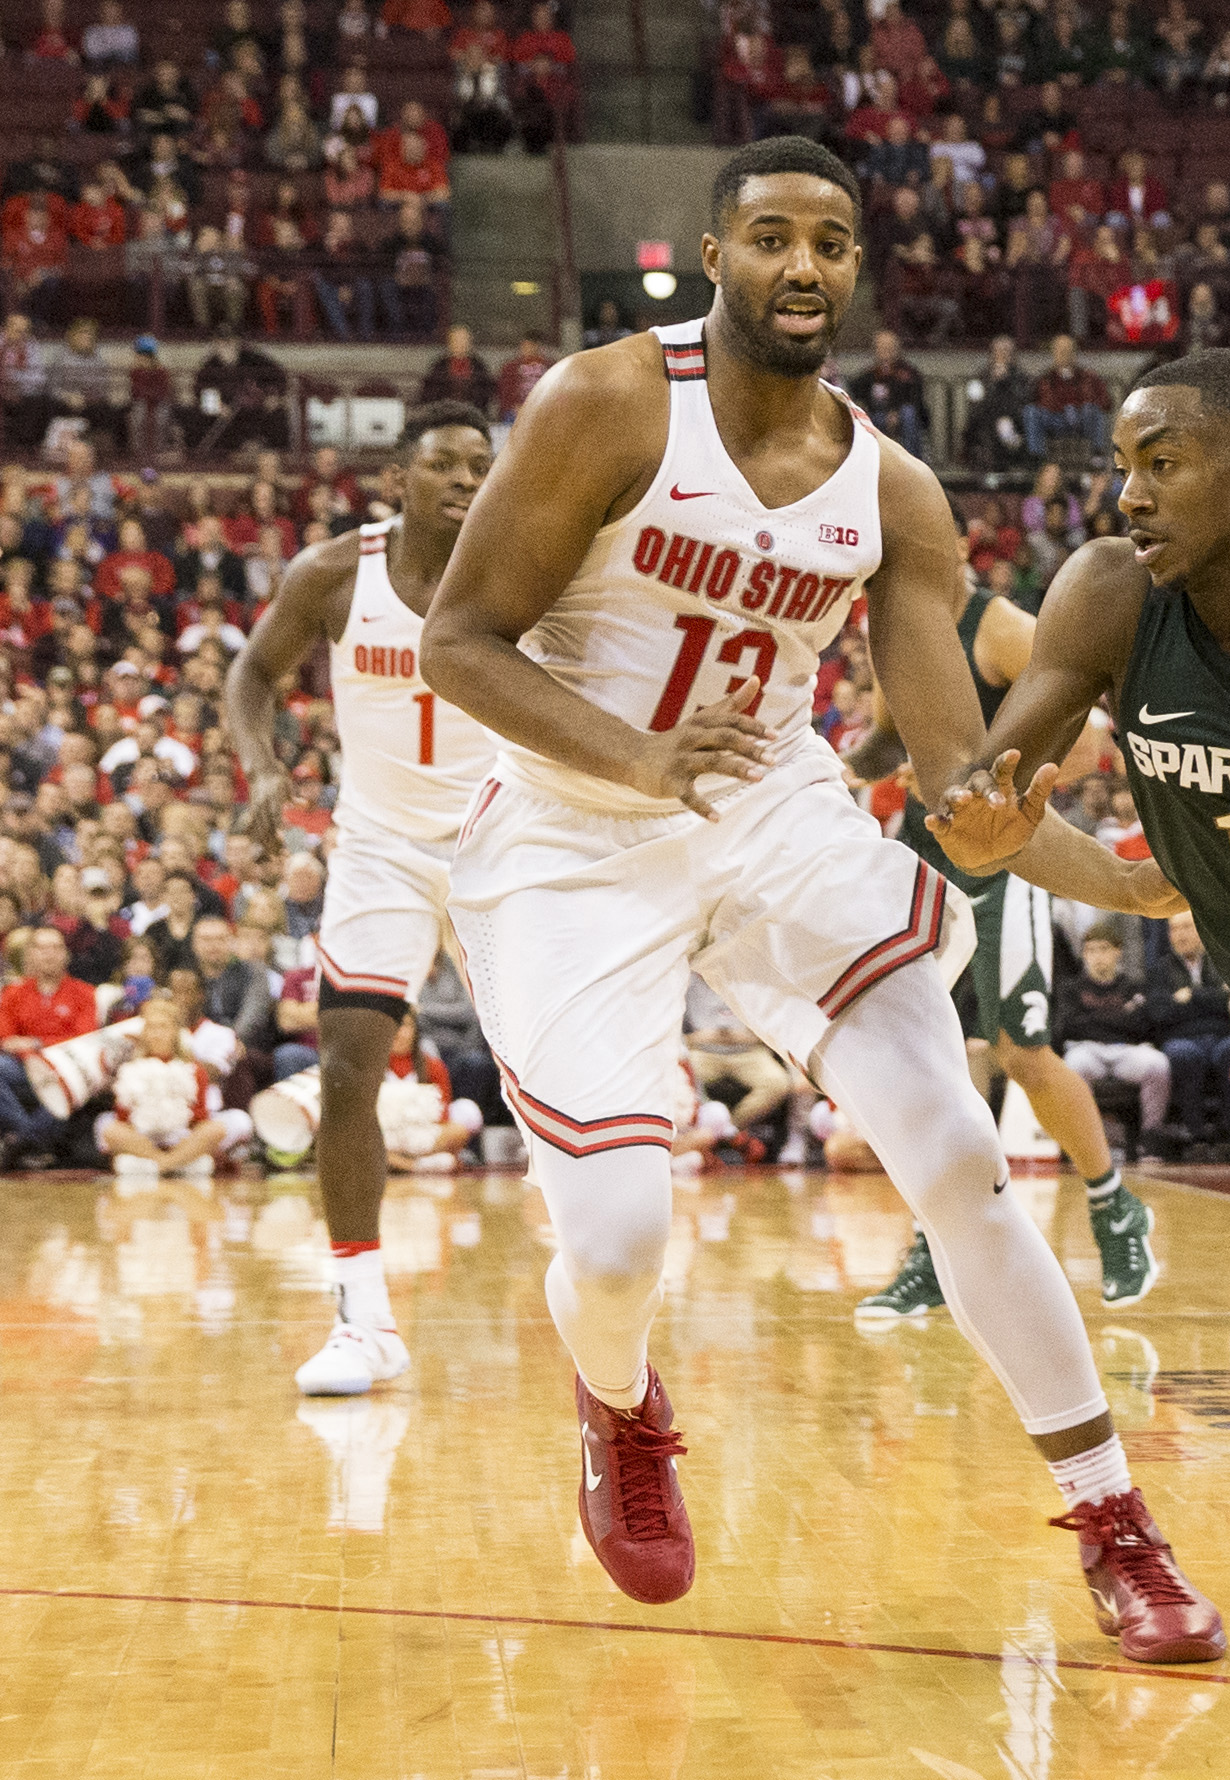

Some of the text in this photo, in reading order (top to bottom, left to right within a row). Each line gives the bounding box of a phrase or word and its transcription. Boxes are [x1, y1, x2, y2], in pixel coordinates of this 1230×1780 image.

[632, 525, 742, 602] OHIO
[355, 644, 415, 679] OHIO
[648, 613, 778, 733] 13
[412, 692, 435, 766] 1
